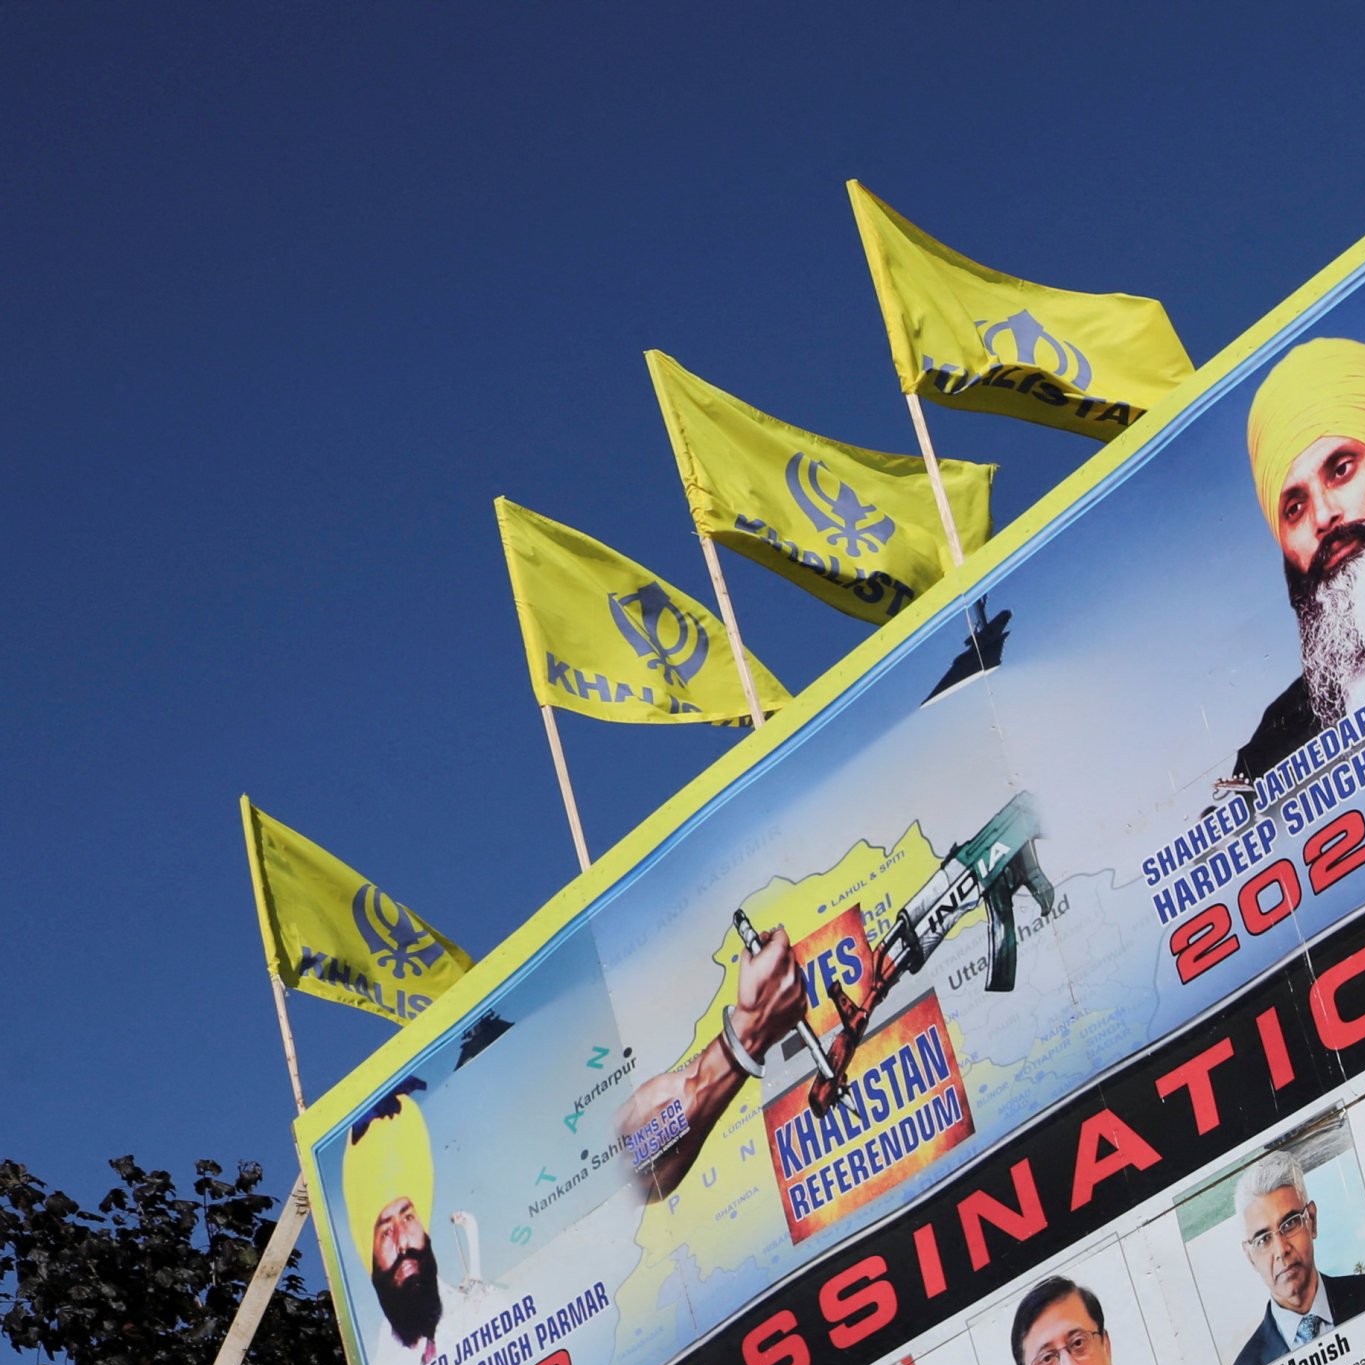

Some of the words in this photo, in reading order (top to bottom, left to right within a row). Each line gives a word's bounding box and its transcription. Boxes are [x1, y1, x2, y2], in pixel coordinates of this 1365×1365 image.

[1142, 796, 1249, 885] SHAHEED
[1153, 820, 1276, 924] HARDEEP
[830, 879, 868, 907] LAHUL
[928, 841, 1011, 933] INDIA
[800, 936, 863, 1009] YES
[574, 1056, 637, 1114] Kartarpur
[776, 1026, 950, 1179] KHALISTAN
[626, 1118, 660, 1151] SIKHS
[661, 1099, 682, 1124] FOR
[633, 1112, 688, 1165] JUSTICE
[789, 1086, 962, 1222] REFERENDUM
[528, 1166, 588, 1218] Nankana
[534, 1281, 610, 1350] PARMAR
